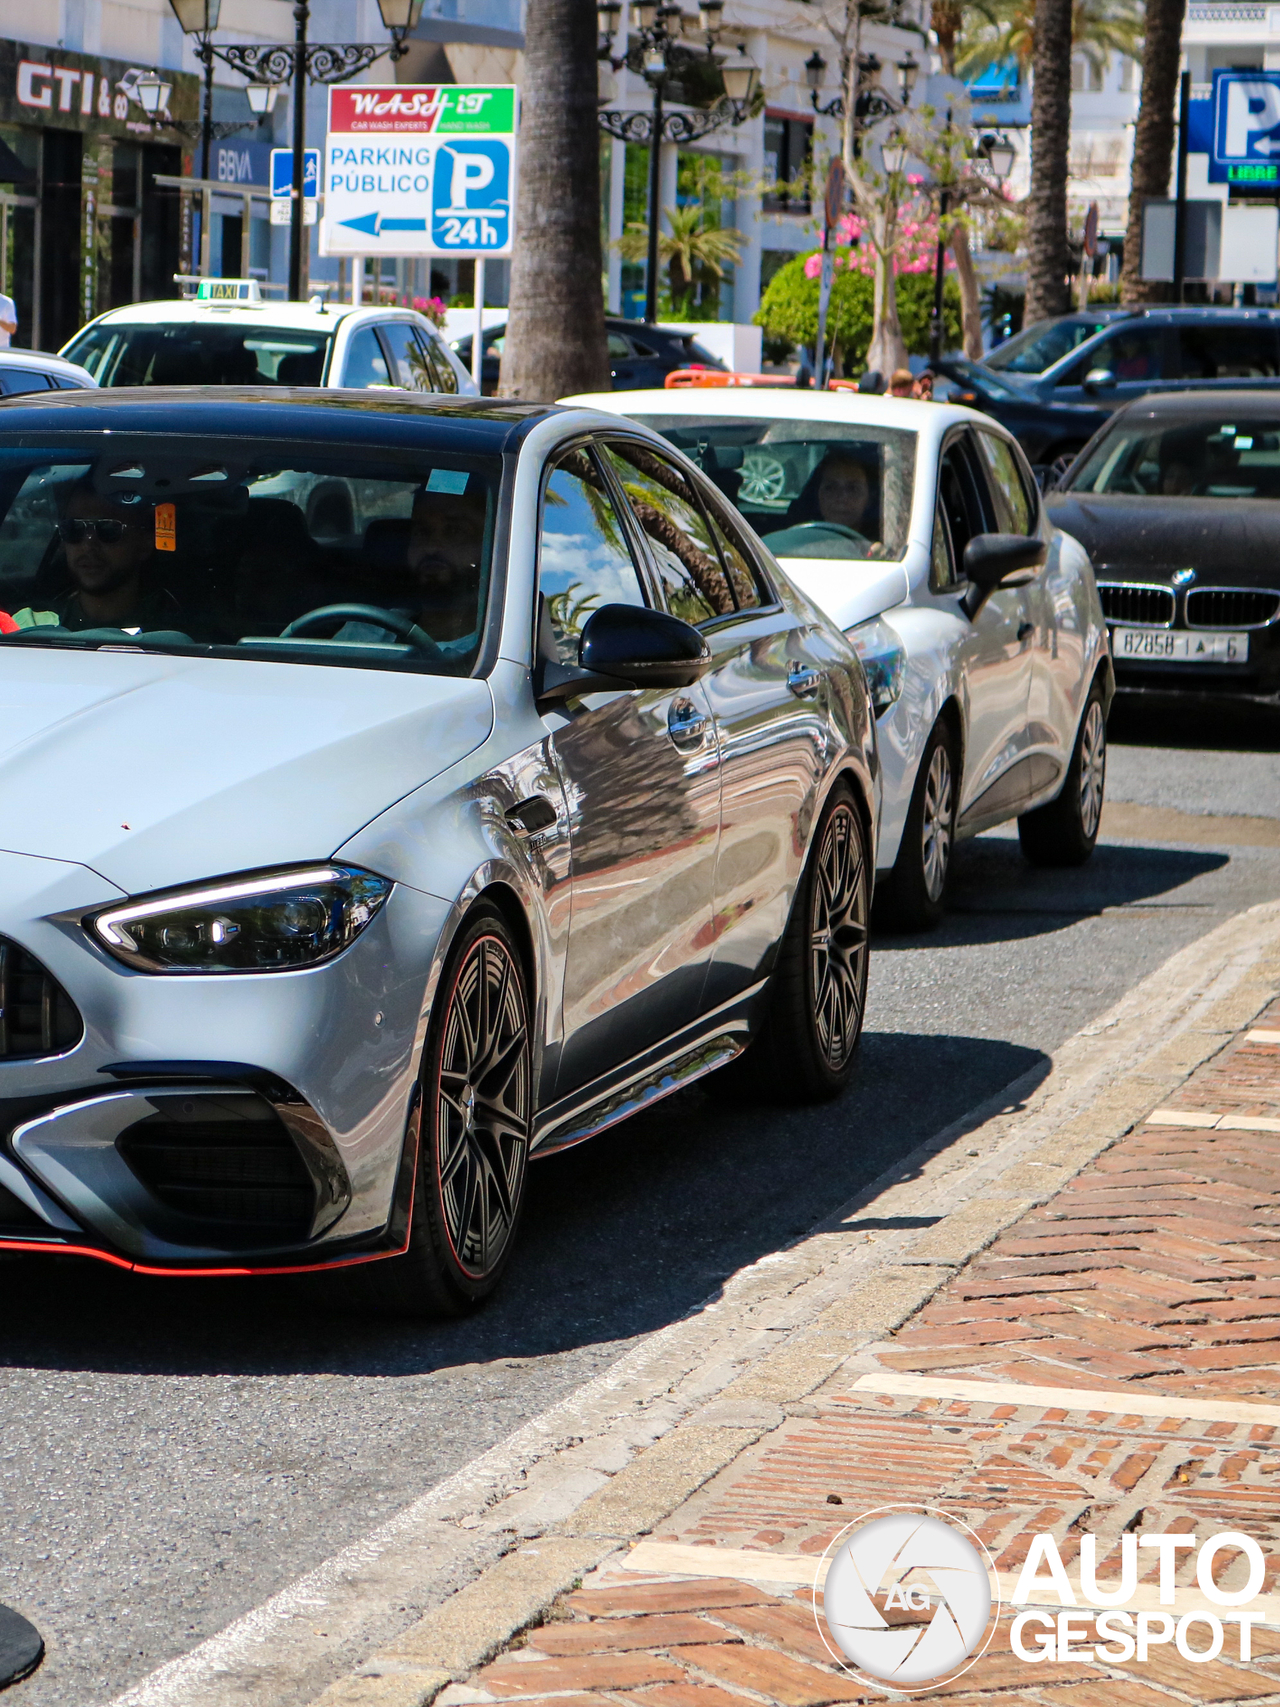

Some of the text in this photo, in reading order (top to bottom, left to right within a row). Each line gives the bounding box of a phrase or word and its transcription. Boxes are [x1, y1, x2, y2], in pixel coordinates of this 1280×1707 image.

[16, 59, 94, 115] GTI
[98, 77, 111, 117] &
[351, 121, 429, 131] CAR WASH EXPERTS
[218, 149, 254, 181] BBVA
[331, 148, 430, 165] PARKING
[331, 170, 430, 192] PÚBLICO
[1228, 166, 1278, 181] LIBRE
[213, 284, 237, 299] TAXI
[1227, 637, 1237, 659] 6
